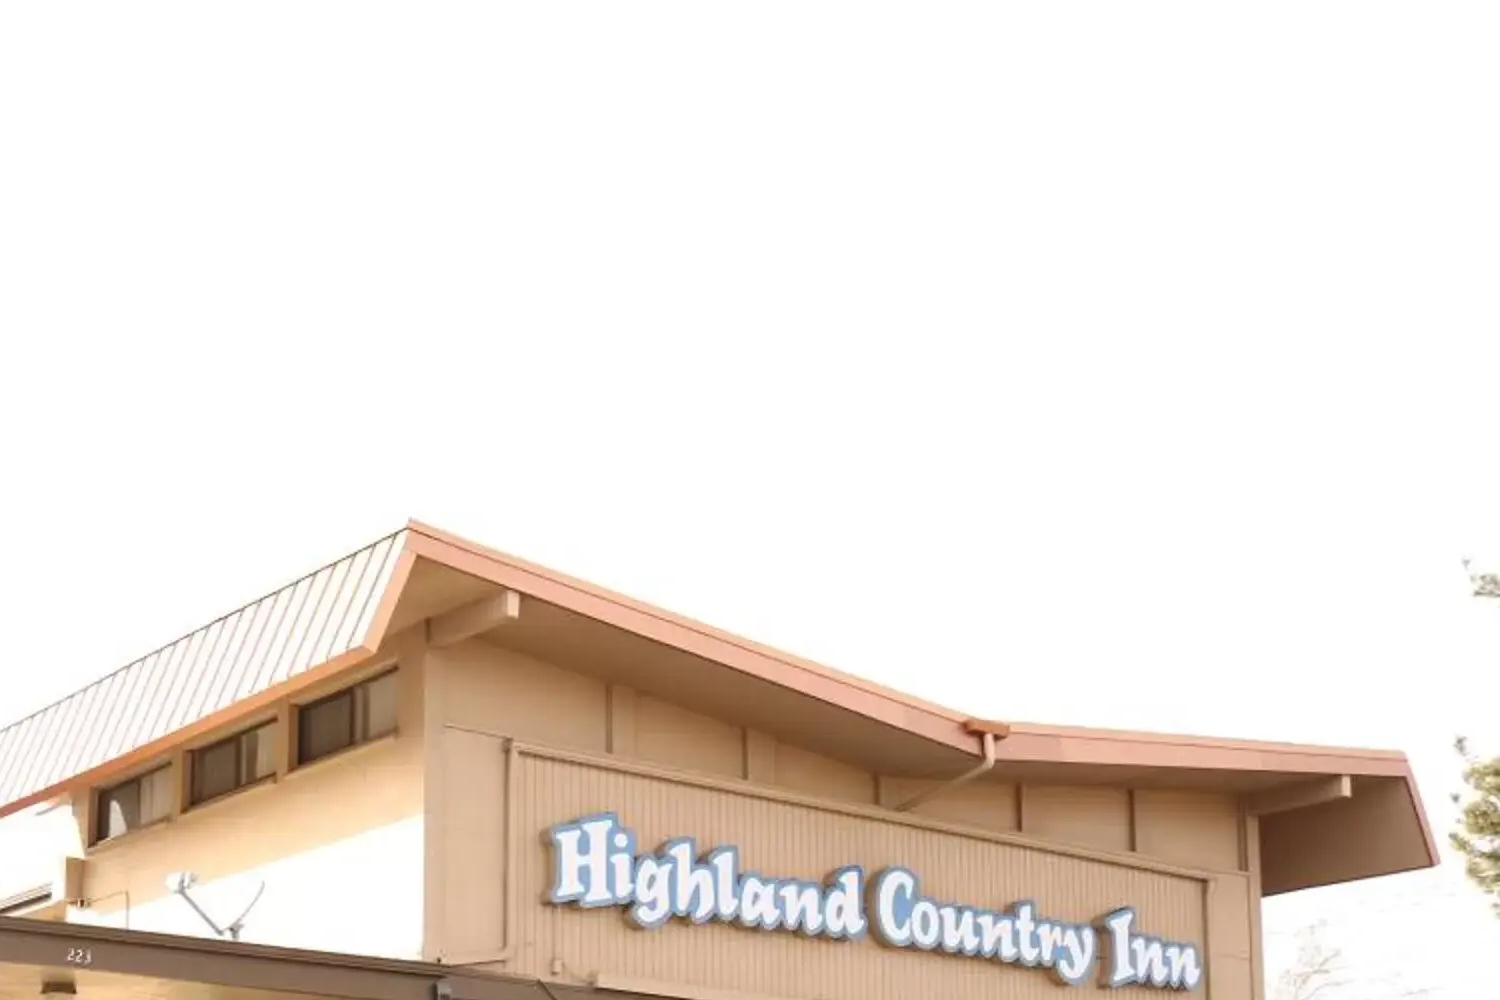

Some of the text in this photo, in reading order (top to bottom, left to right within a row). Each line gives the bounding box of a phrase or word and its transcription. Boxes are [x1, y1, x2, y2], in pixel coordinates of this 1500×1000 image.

[550, 813, 1200, 991] Highland Country Inn
